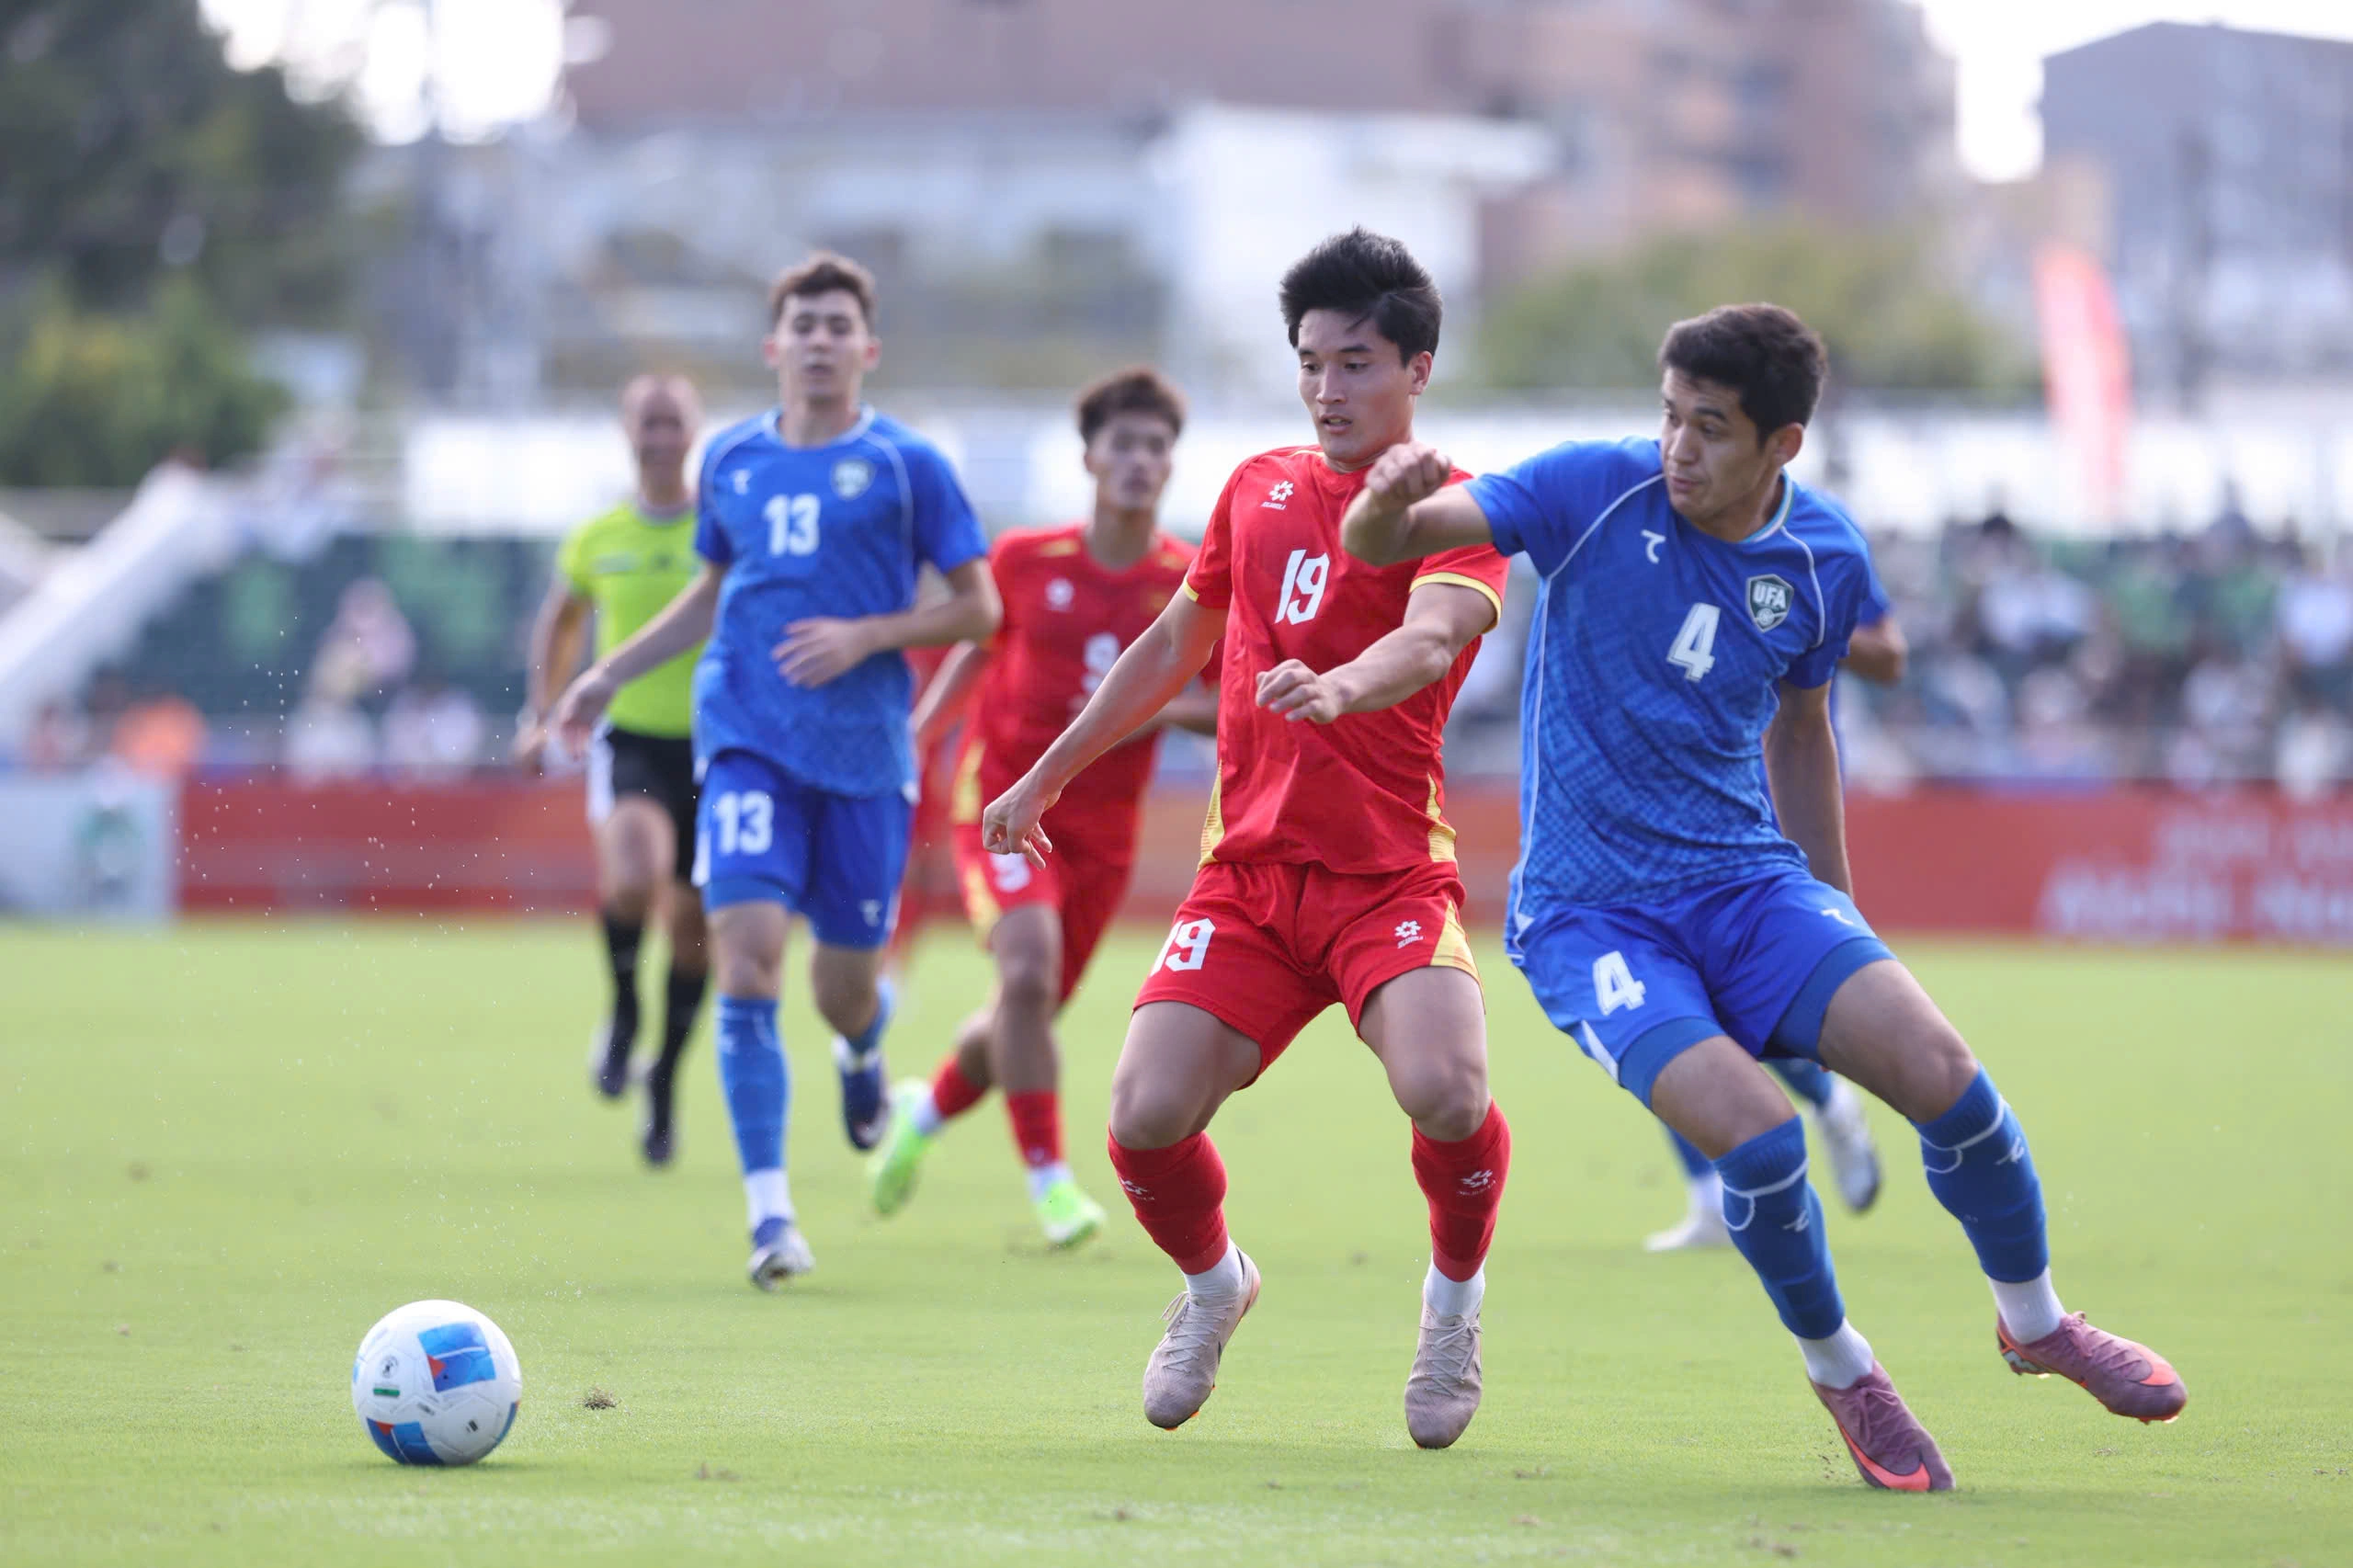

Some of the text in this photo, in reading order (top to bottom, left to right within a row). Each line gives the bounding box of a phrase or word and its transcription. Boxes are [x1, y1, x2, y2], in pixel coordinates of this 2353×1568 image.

[763, 494, 821, 556] 13
[1274, 549, 1330, 625] 19
[1753, 581, 1787, 609] UFA
[1665, 602, 1722, 682] 4
[715, 791, 774, 854] 13
[1149, 917, 1216, 978] 19
[1592, 949, 1647, 1016] 4
